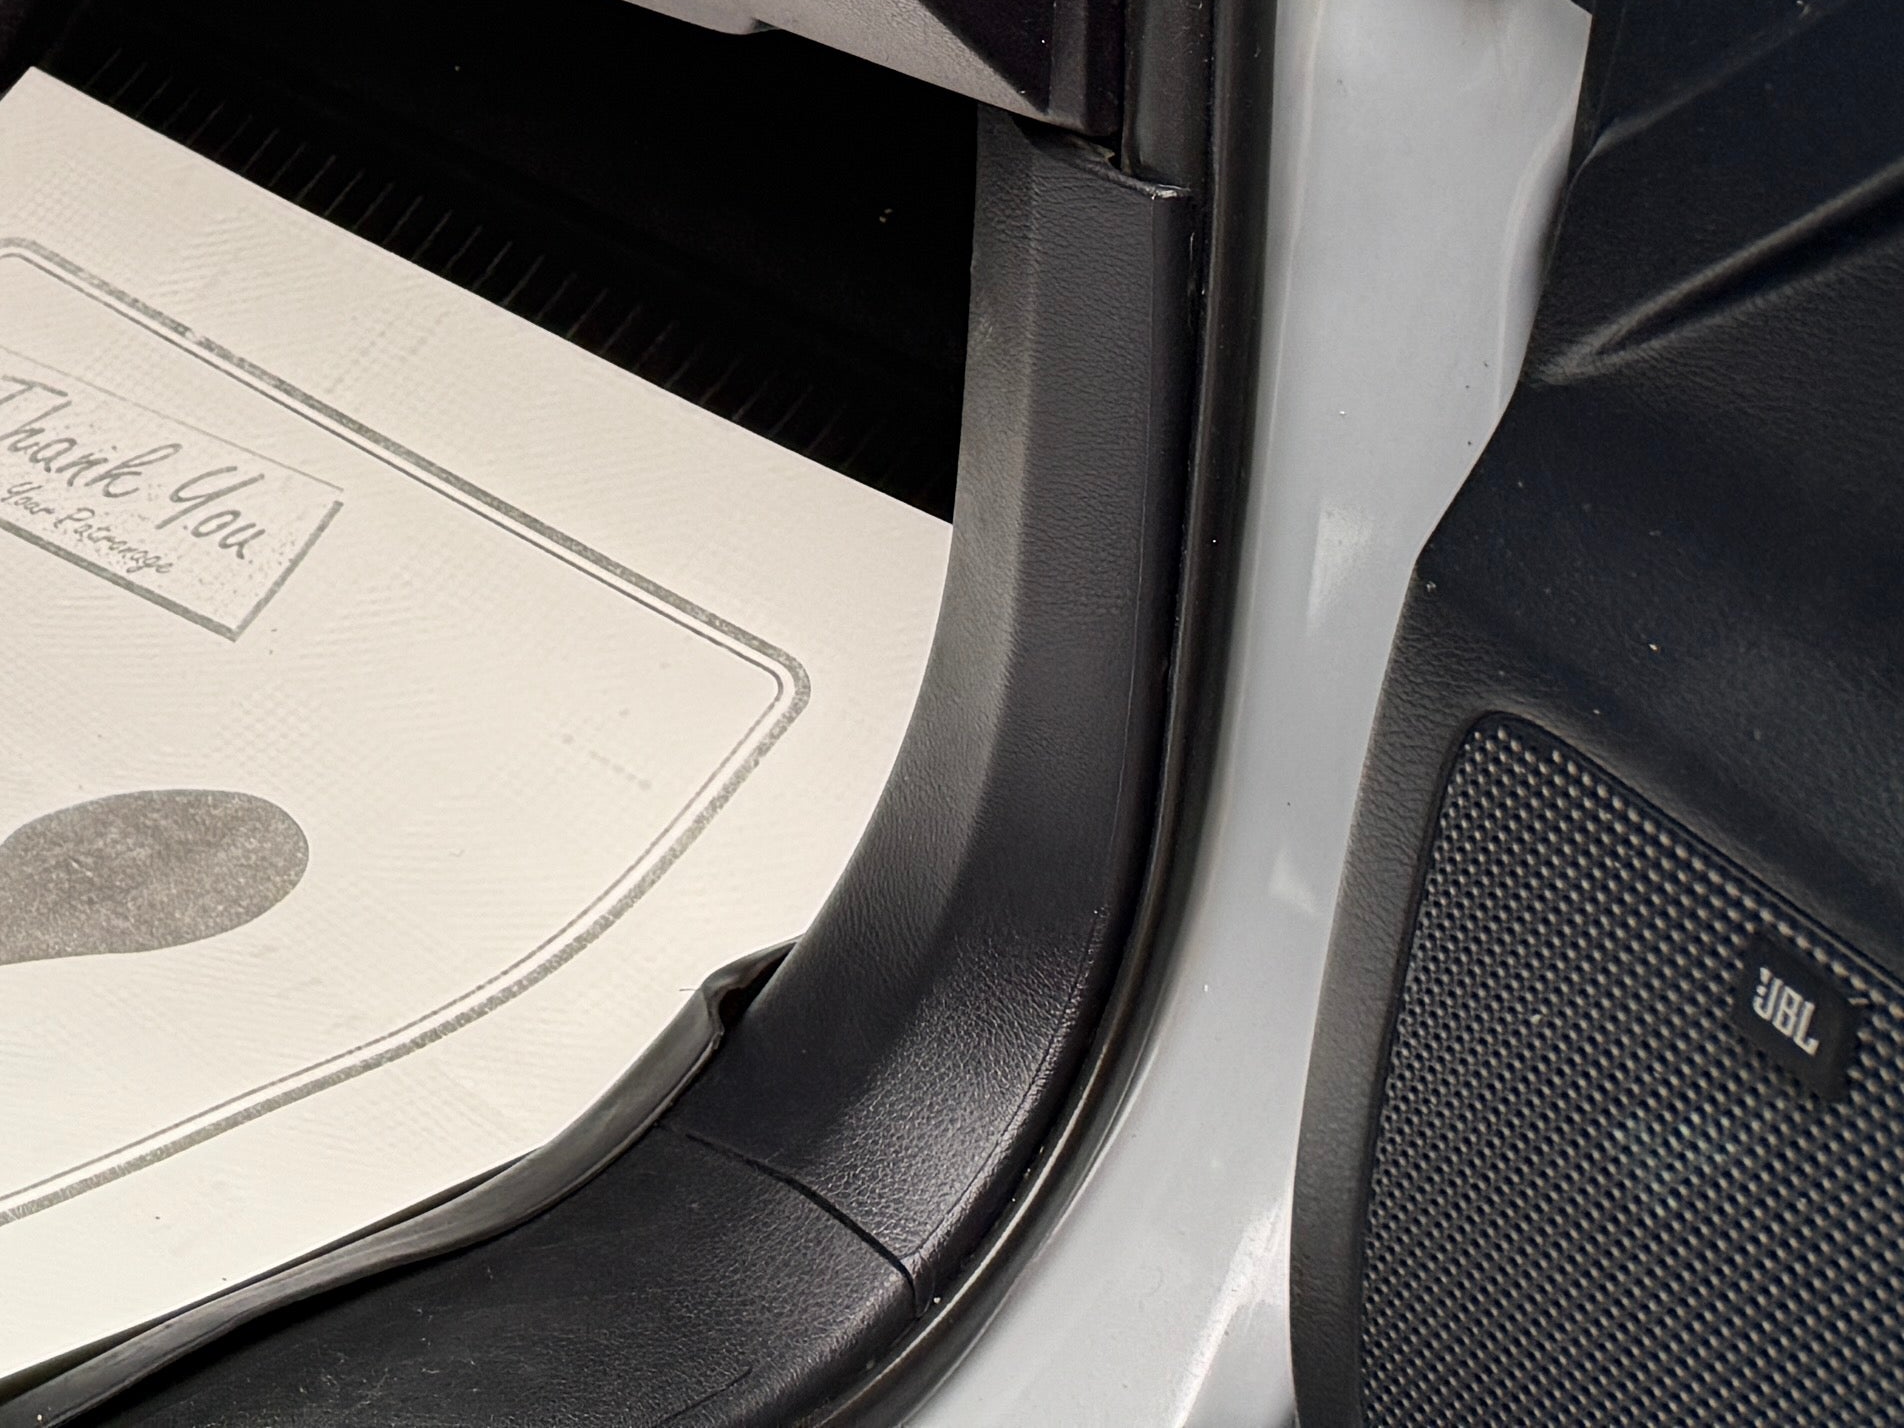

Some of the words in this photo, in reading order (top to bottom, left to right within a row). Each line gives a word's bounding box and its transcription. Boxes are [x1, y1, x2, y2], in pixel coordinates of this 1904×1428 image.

[0, 481, 55, 515] Your
[54, 507, 174, 574] Patronage
[154, 465, 266, 560] You
[1752, 967, 1820, 1056] JBL
